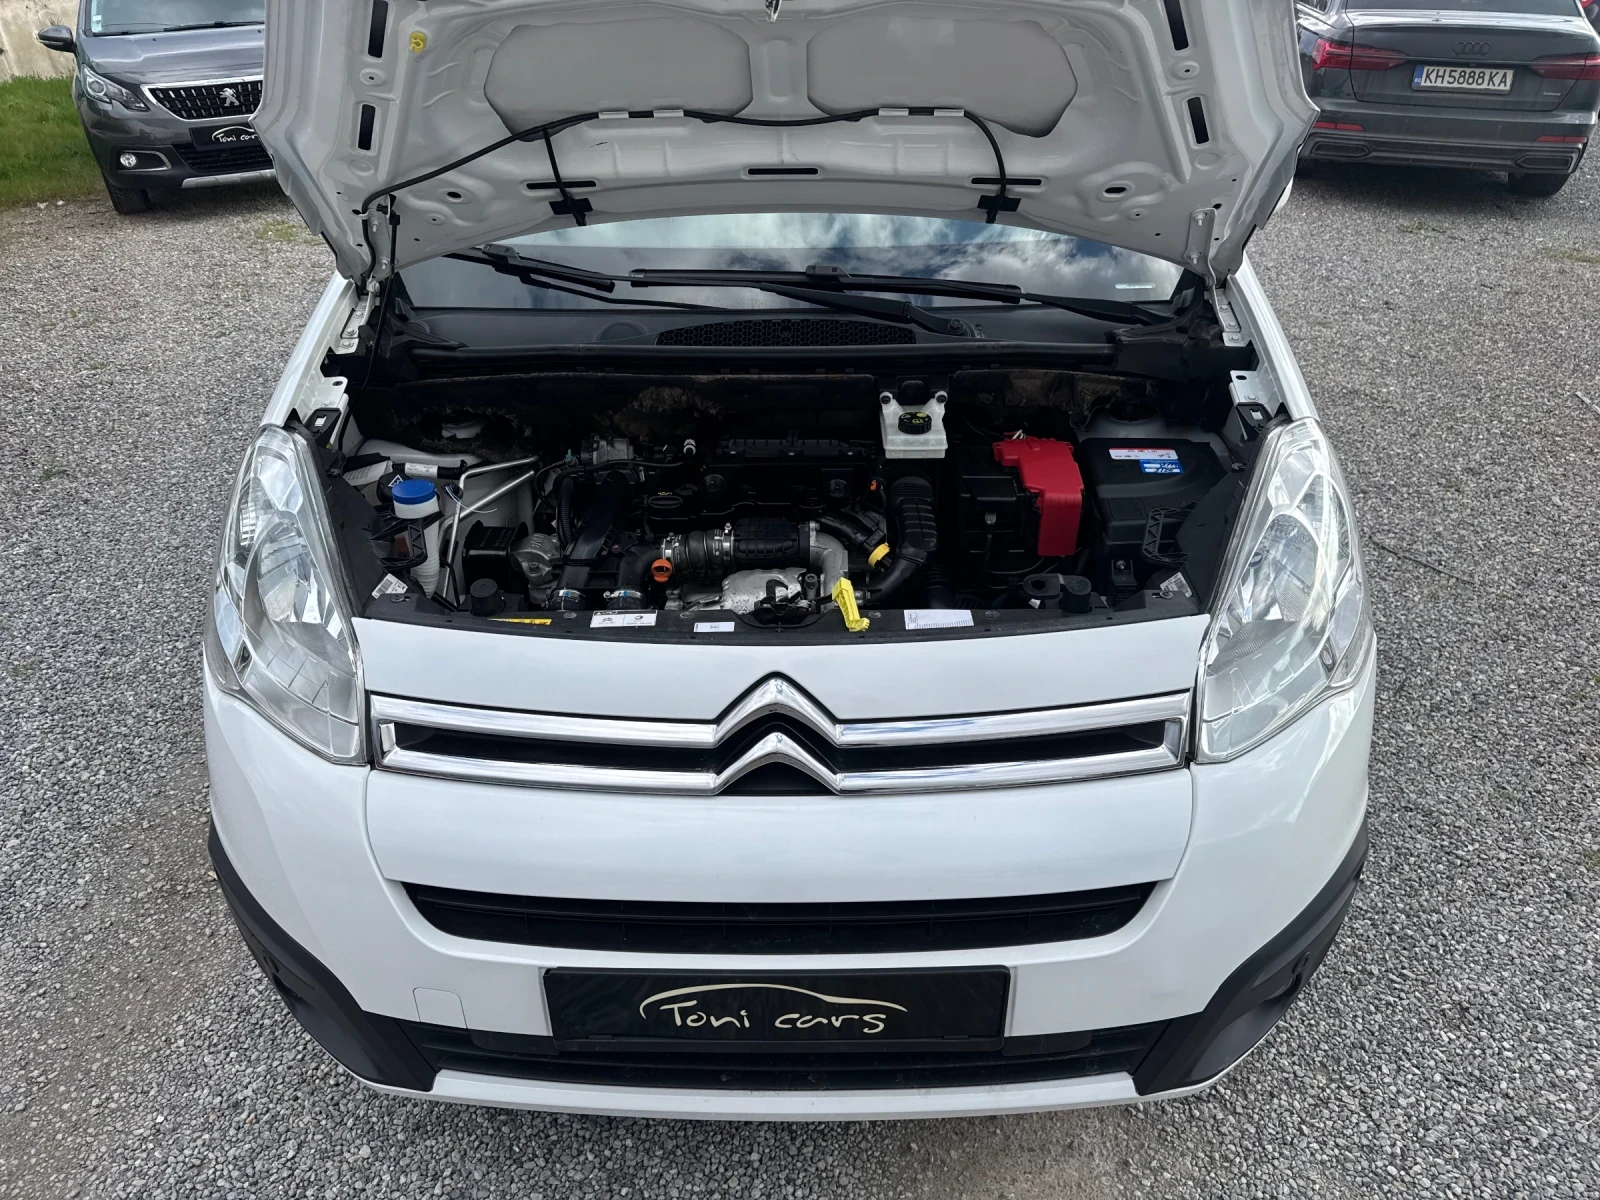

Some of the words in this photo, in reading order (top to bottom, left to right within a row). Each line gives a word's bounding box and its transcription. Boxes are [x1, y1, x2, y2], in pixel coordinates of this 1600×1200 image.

[216, 133, 237, 143] Toni
[659, 999, 751, 1029] Toni
[774, 1012, 887, 1034] cars
